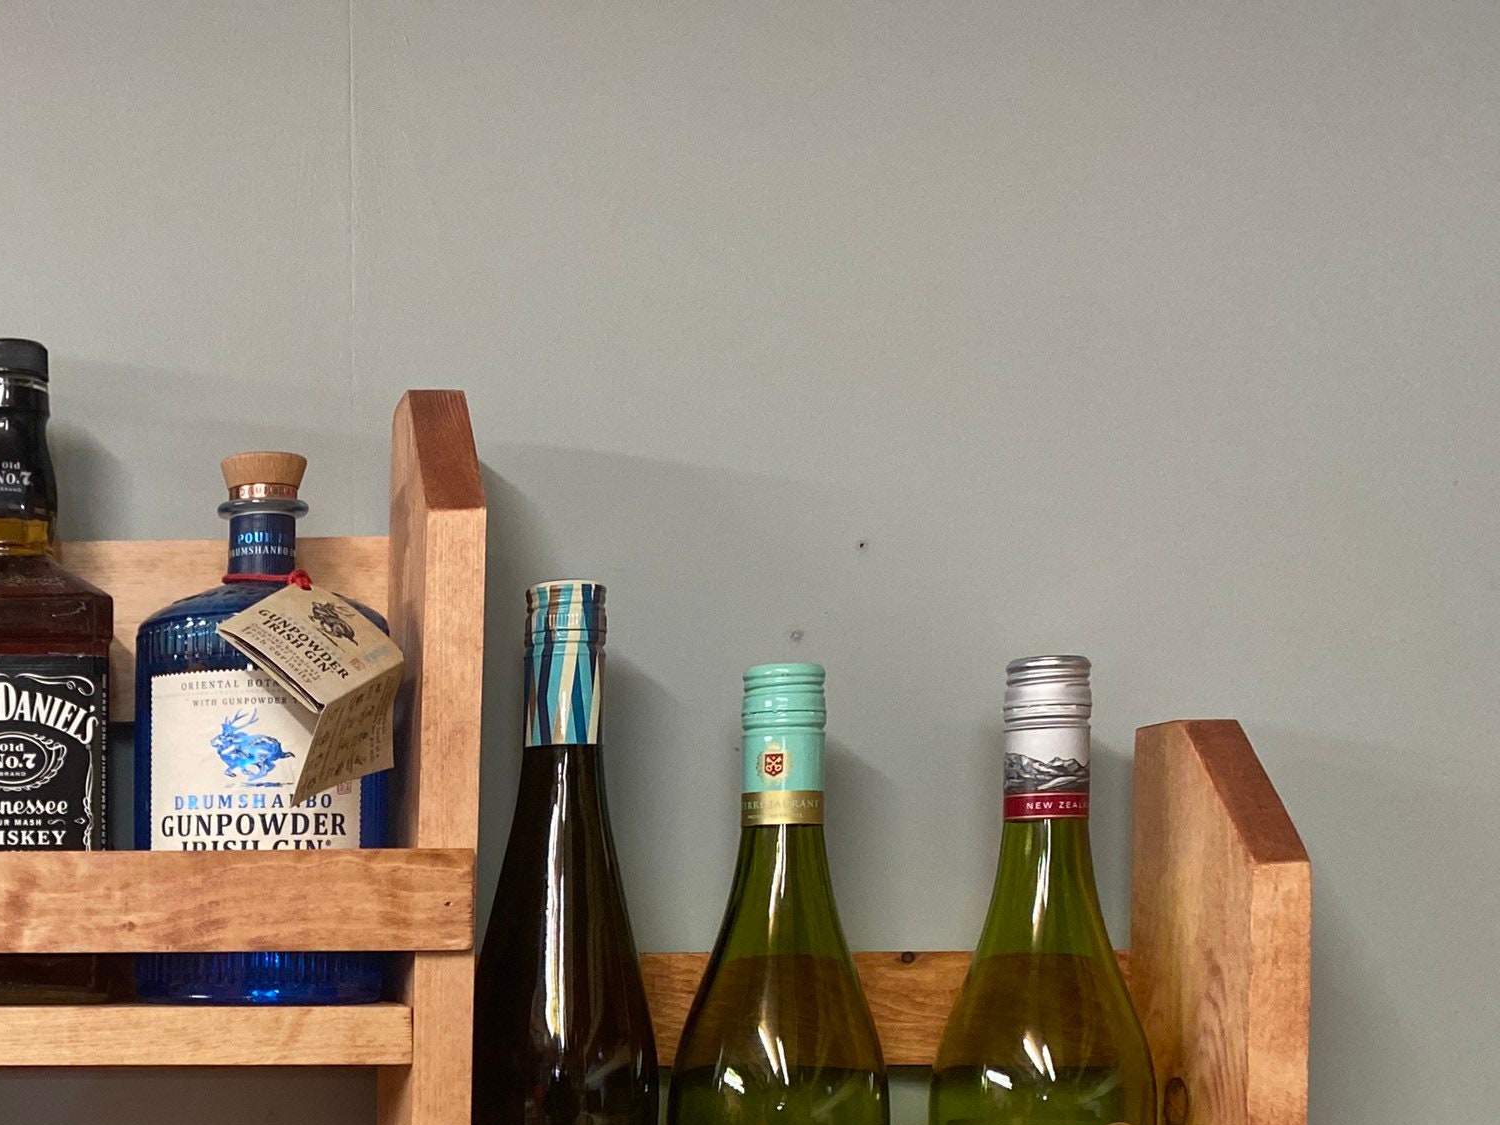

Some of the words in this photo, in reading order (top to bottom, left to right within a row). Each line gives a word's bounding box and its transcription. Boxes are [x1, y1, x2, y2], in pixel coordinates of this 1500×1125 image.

[262, 619, 305, 649] IRISH
[258, 609, 350, 679] GUNPOWDER
[181, 680, 240, 691] ORIENTAL
[192, 699, 217, 707] WITH
[222, 696, 287, 706] GUNPOWDER
[0, 742, 24, 752] Old
[174, 794, 332, 810] DRUMSHABO
[1026, 802, 1054, 810] NEW
[14, 818, 42, 827] MASH
[162, 813, 347, 837] GUNPOWDER
